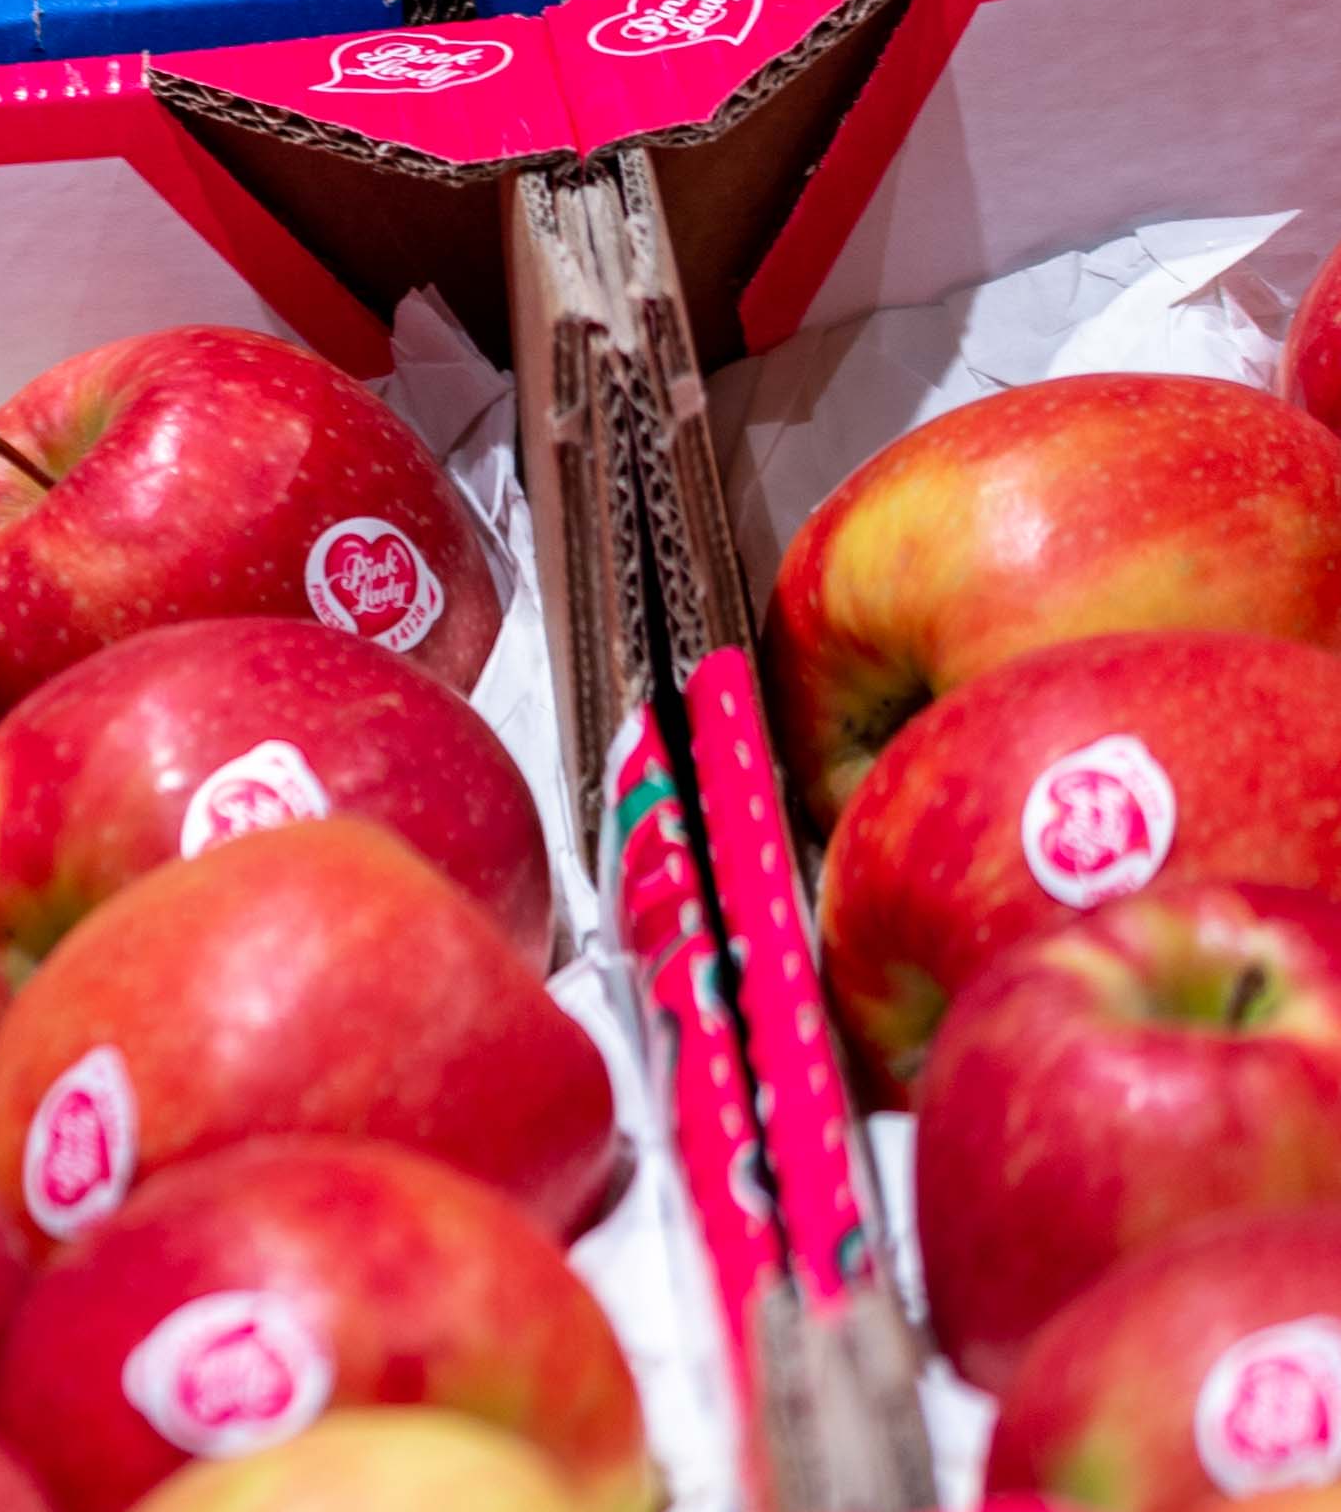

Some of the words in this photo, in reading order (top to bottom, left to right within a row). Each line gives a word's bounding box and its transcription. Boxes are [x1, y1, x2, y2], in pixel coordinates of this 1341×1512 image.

[355, 41, 485, 66] Pink
[342, 59, 464, 87] Lady
[338, 546, 399, 591] Pink
[349, 575, 411, 616] Lady
